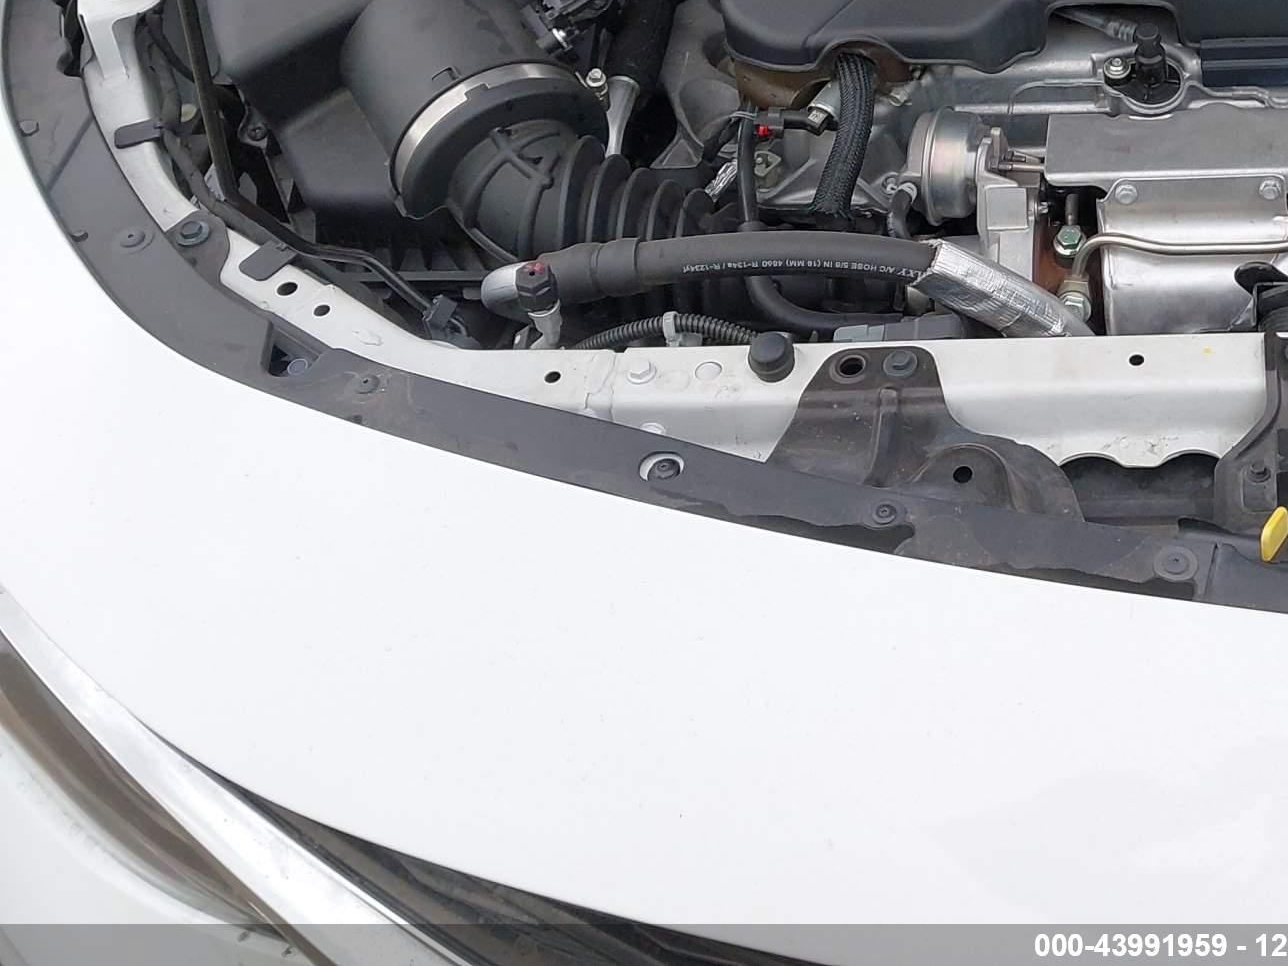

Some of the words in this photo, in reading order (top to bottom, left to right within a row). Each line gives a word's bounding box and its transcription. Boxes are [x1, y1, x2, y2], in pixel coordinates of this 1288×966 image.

[785, 259, 805, 269] MM)
[823, 260, 833, 269] IN
[835, 261, 849, 270] 5/8
[851, 262, 877, 272] HOSE
[879, 265, 896, 274] A/C
